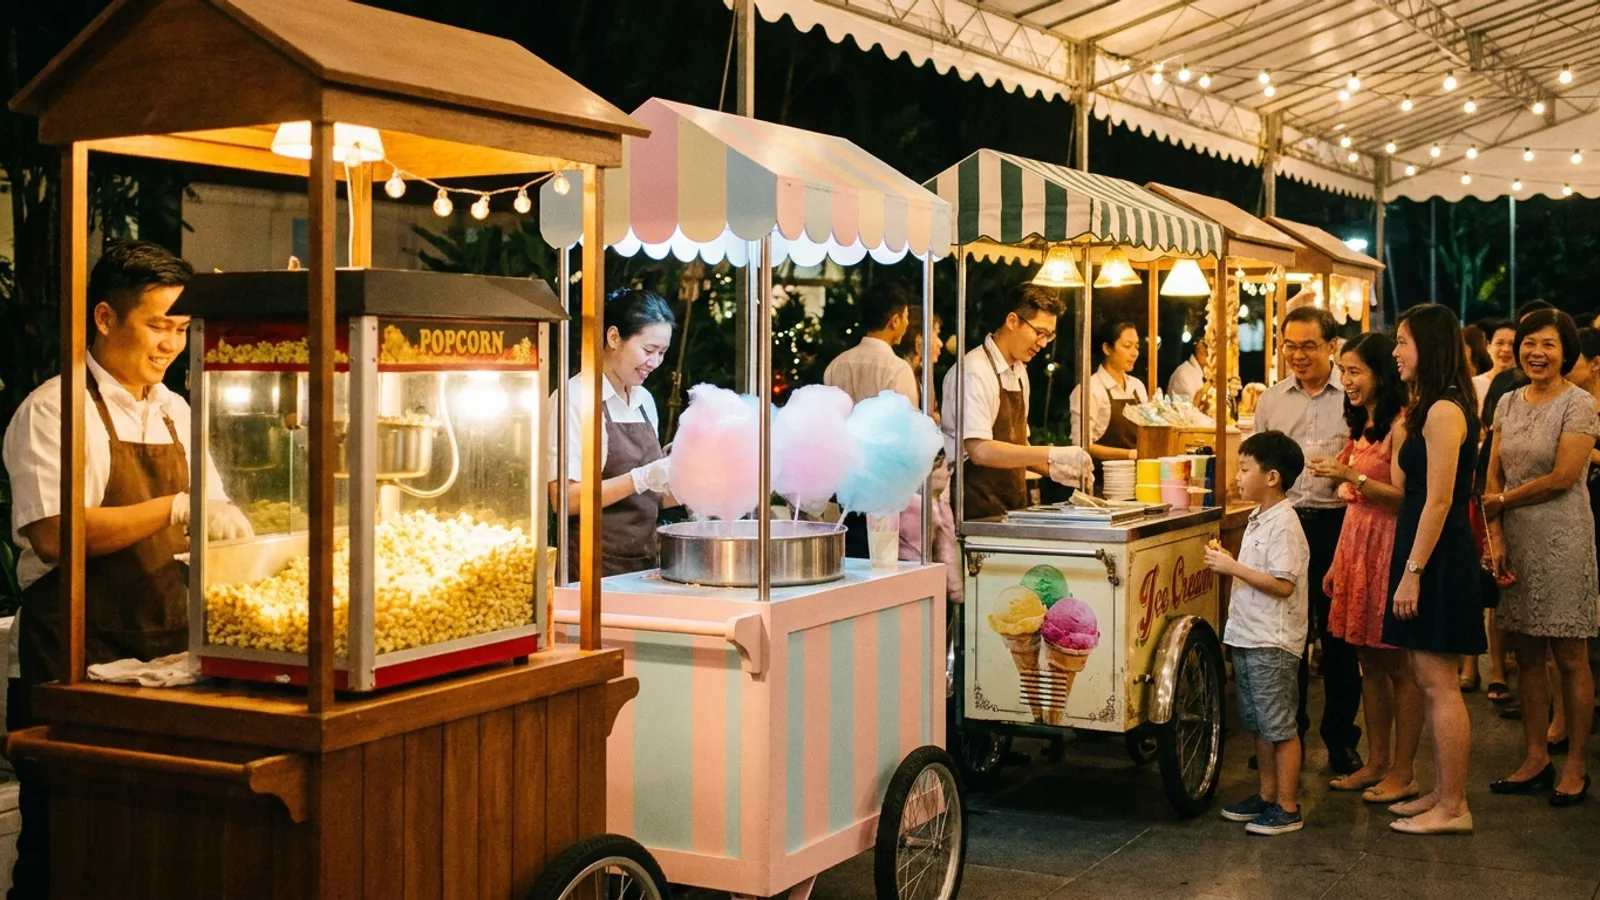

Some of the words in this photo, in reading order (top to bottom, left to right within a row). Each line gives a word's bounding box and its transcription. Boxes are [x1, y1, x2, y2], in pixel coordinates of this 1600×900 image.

[419, 328, 505, 354] POPCORN
[1137, 564, 1169, 644] Ice
[1172, 555, 1214, 610] Cream
